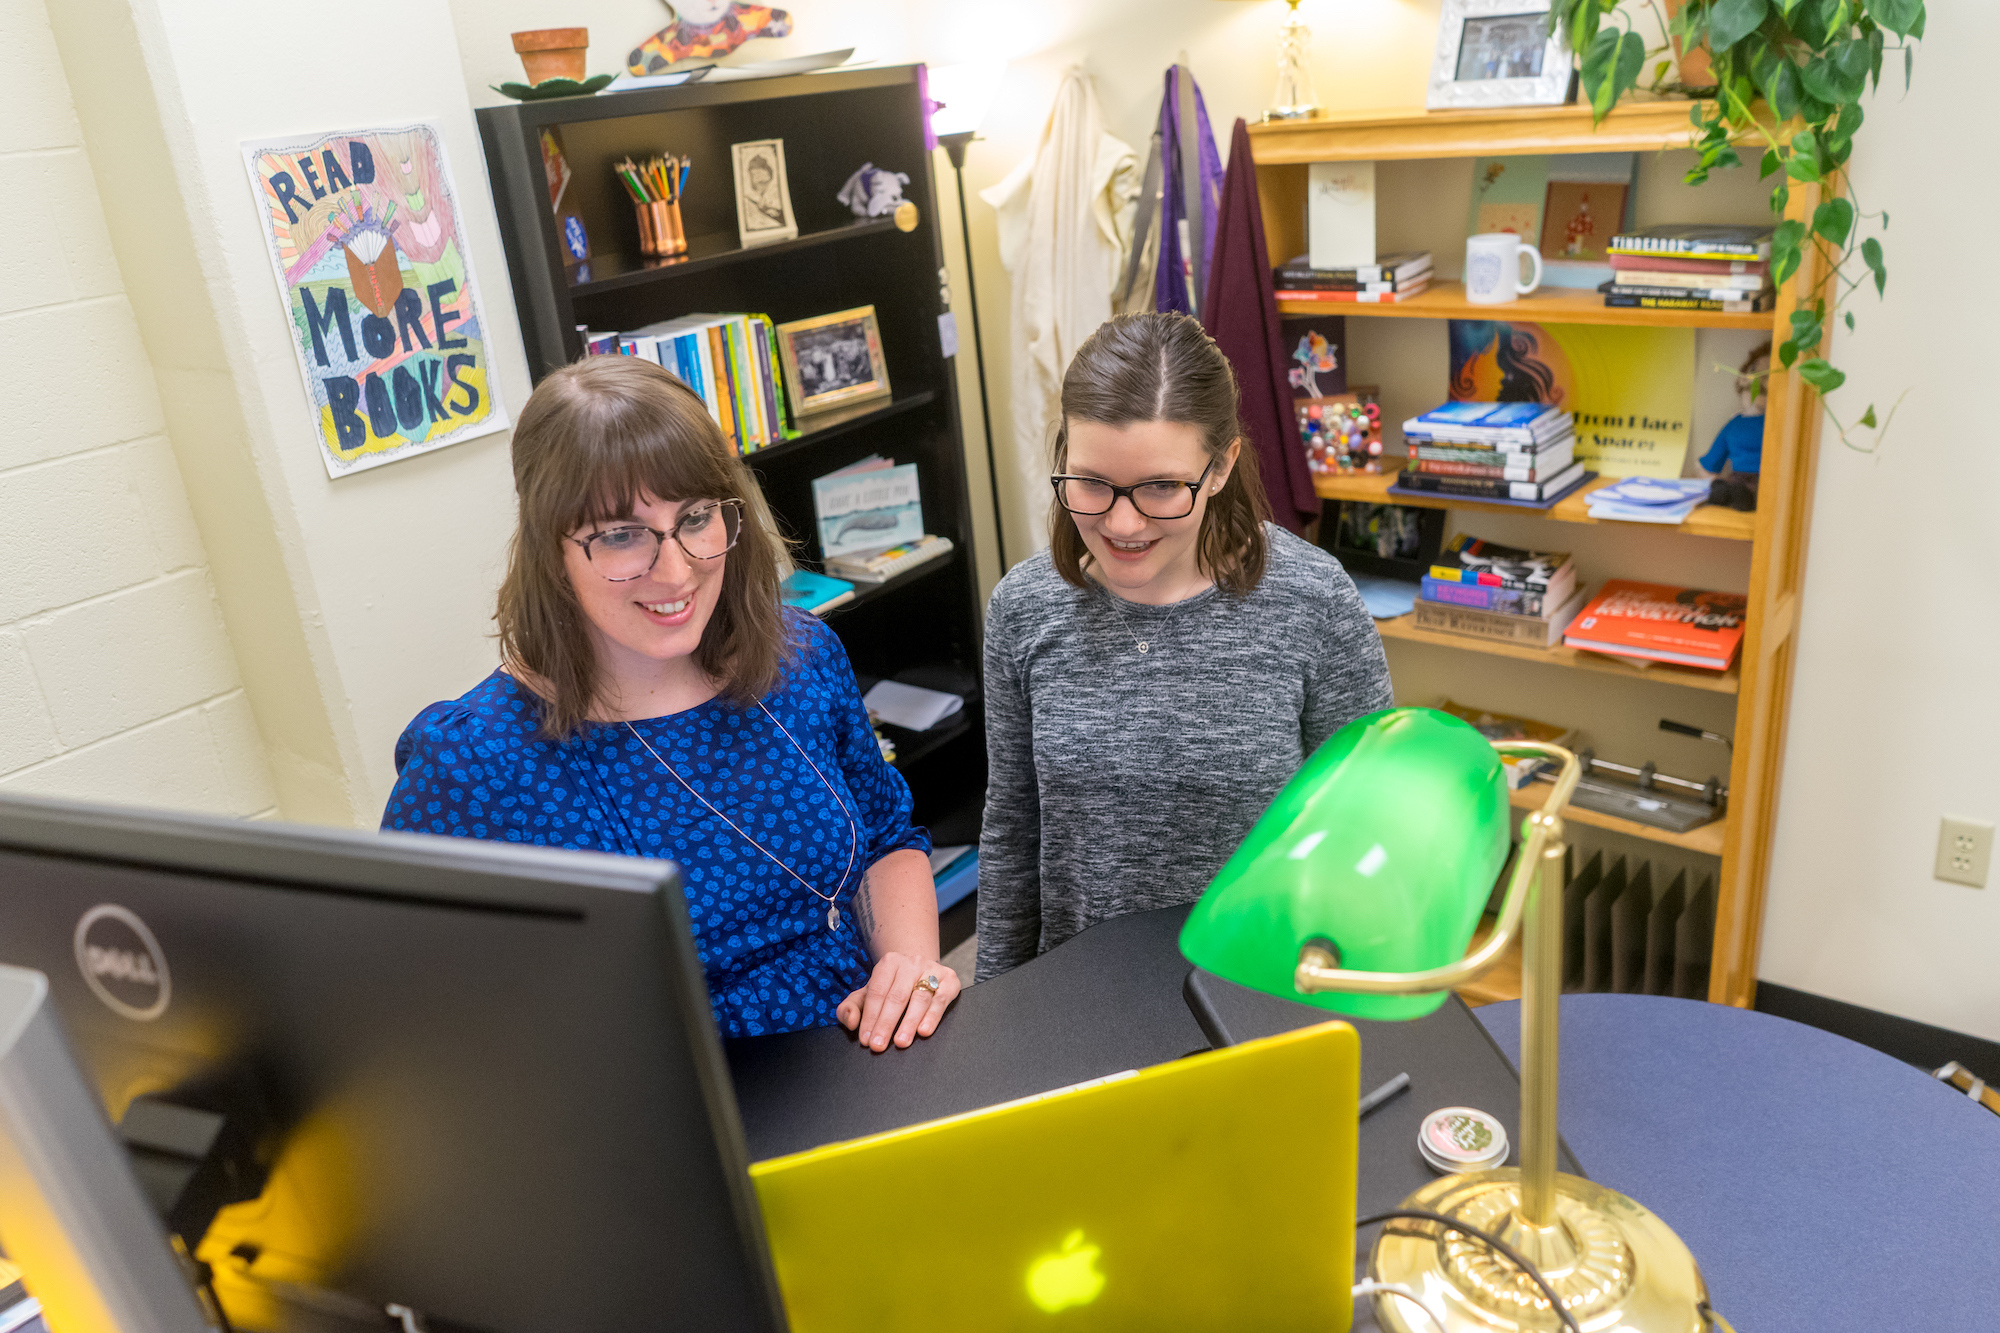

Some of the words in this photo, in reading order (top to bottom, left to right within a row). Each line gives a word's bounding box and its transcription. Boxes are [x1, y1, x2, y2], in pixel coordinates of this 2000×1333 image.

[270, 141, 375, 225] READ
[1611, 235, 1686, 253] TINDERBOX
[299, 277, 468, 368] MORE
[321, 353, 480, 451] BOOKS
[1594, 605, 1738, 626] REVOLUTION
[85, 945, 157, 985] DELL
